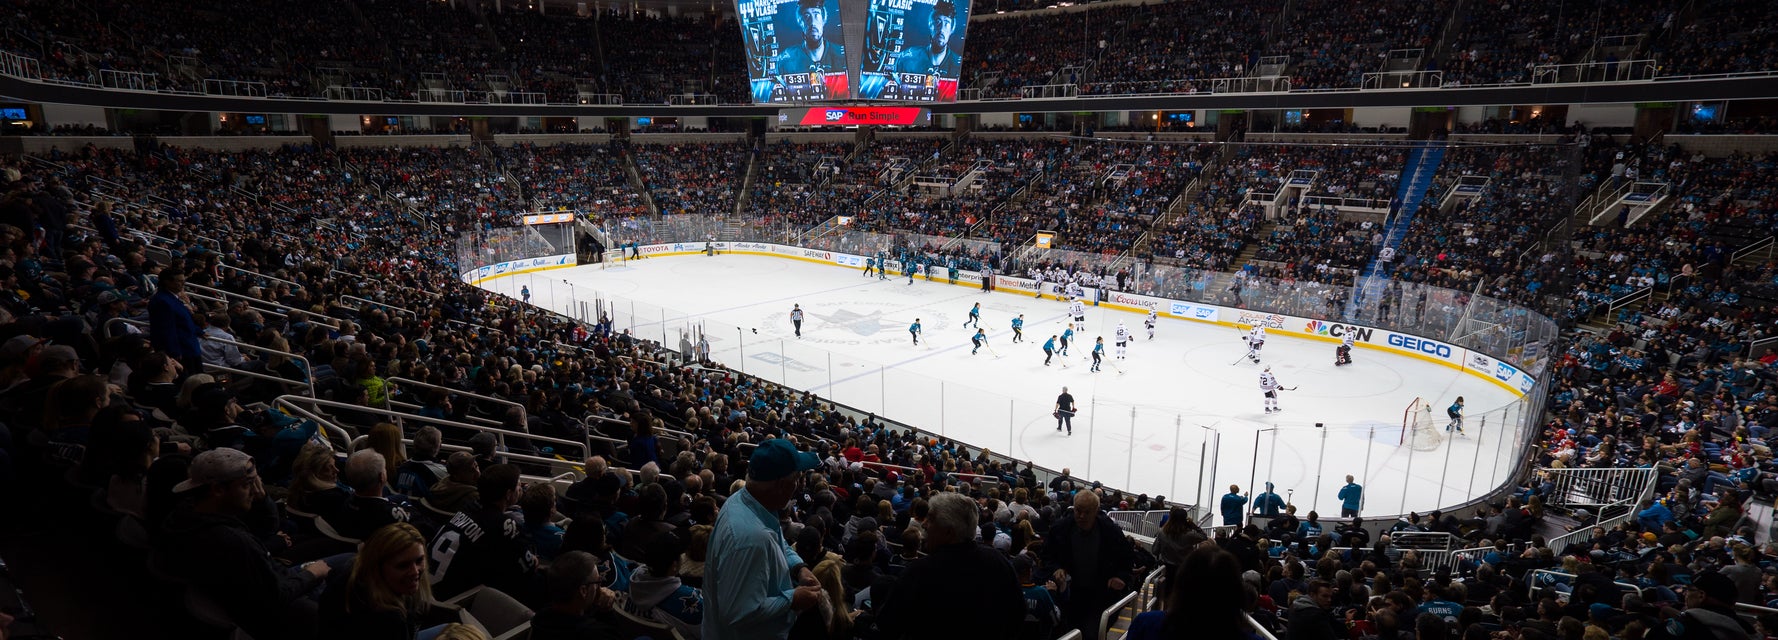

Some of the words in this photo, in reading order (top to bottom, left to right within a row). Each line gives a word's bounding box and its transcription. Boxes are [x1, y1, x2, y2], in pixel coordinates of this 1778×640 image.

[740, 2, 754, 18] 44
[888, 0, 912, 10] VLASIC
[756, 5, 777, 17] VLASIC
[788, 75, 806, 84] 3:31
[904, 75, 922, 84] 3:31
[826, 111, 843, 120] SAP
[848, 112, 867, 120] Run
[870, 112, 899, 121] Simple
[804, 250, 824, 258] SAFEWAY
[958, 272, 982, 280] nterpri
[1000, 278, 1036, 290] ThreatMetri
[1116, 294, 1138, 305] Coors
[1238, 316, 1284, 330] AMRICA
[1388, 333, 1451, 358] GEICO
[1496, 364, 1513, 379] SAP
[1428, 607, 1453, 615] BURNS
